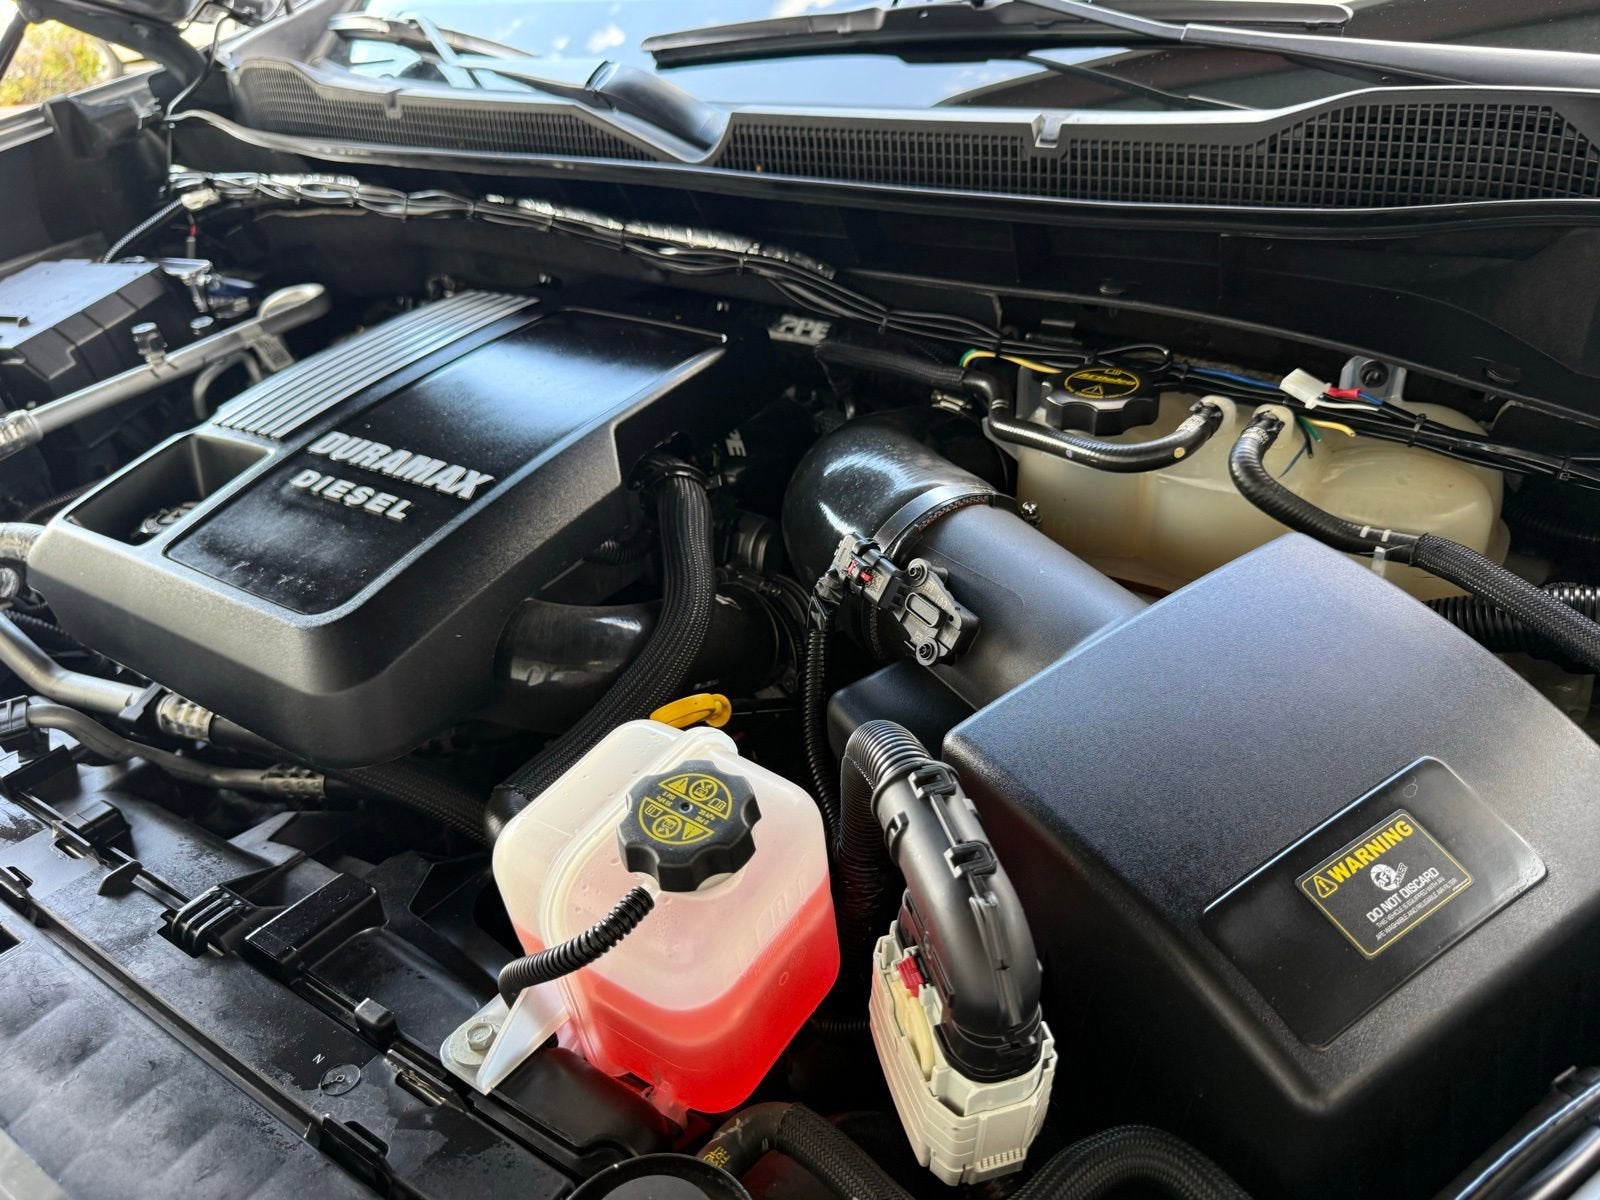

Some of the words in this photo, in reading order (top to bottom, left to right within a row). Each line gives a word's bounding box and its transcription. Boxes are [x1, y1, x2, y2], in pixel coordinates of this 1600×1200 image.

[307, 430, 496, 500] DURAMAX
[288, 468, 415, 522] DIESEL
[1327, 820, 1414, 884] WARNING
[1366, 907, 1384, 922] DO
[1380, 894, 1403, 912] NOT
[1399, 867, 1439, 898] DISCARD
